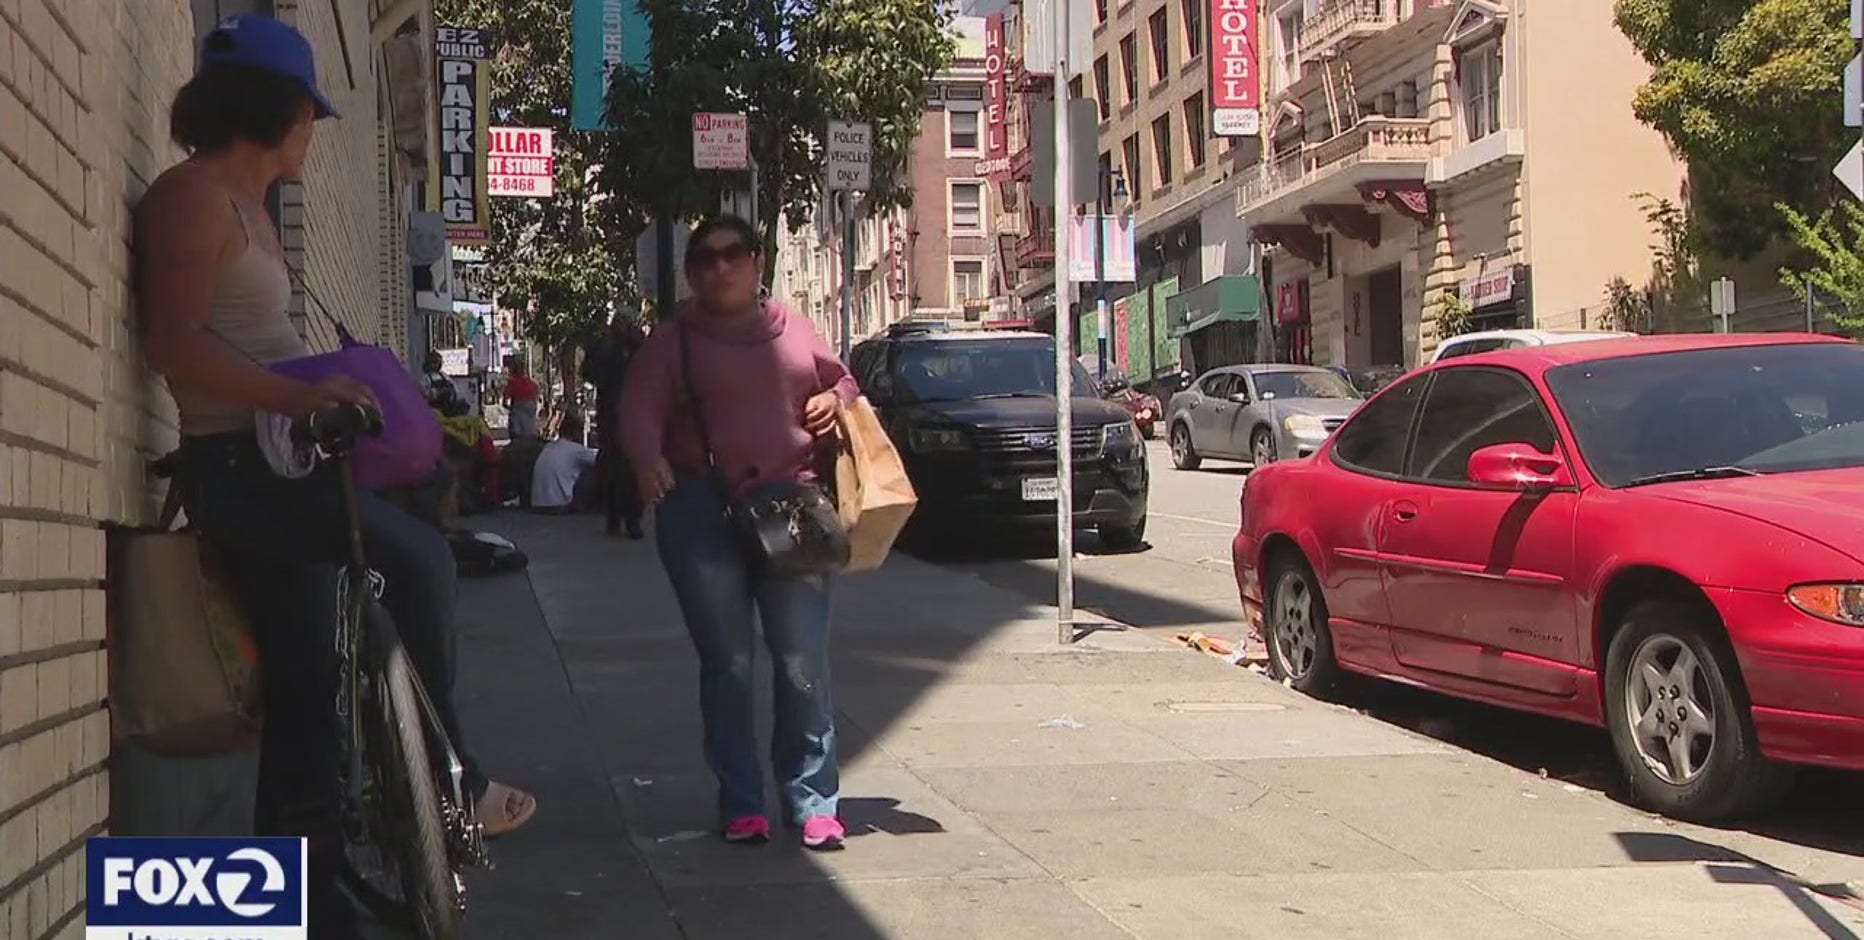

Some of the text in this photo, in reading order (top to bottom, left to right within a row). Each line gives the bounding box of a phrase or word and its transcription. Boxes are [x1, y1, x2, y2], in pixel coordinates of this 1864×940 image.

[437, 28, 479, 43] EZ
[436, 42, 485, 58] UBLIC
[1220, 0, 1248, 100] HOTEL
[986, 29, 1000, 149] HOTEL
[695, 115, 745, 130] NO PARKING
[441, 60, 473, 222] PARKING
[834, 132, 865, 144] POLICE
[830, 150, 869, 163] VEHICLES
[505, 158, 548, 174] STORE
[837, 169, 860, 181] ONLY
[446, 230, 466, 238] NTER
[894, 226, 904, 294] HOTEL
